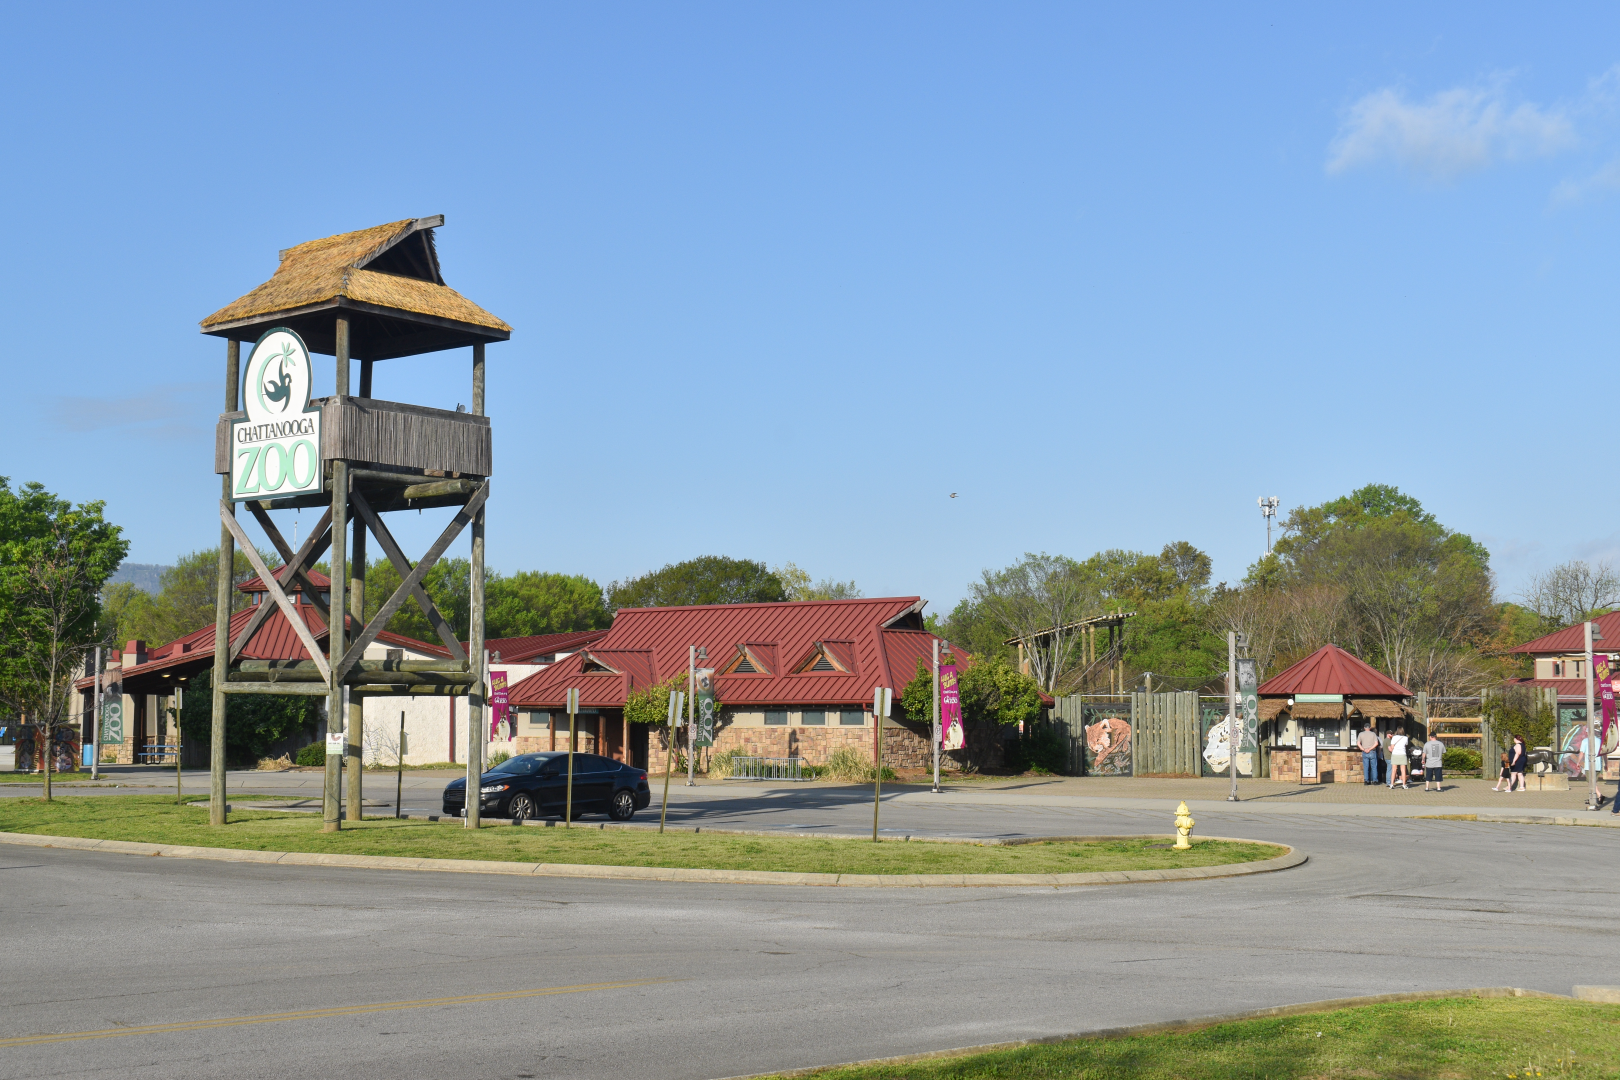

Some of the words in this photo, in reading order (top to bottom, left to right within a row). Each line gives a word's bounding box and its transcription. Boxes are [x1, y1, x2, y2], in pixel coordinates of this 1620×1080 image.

[237, 418, 315, 443] CHATTANOOGA
[235, 439, 317, 495] ZOO
[109, 702, 121, 742] ZOO
[702, 697, 713, 743] ZOO
[1246, 694, 1258, 748] ZOO
